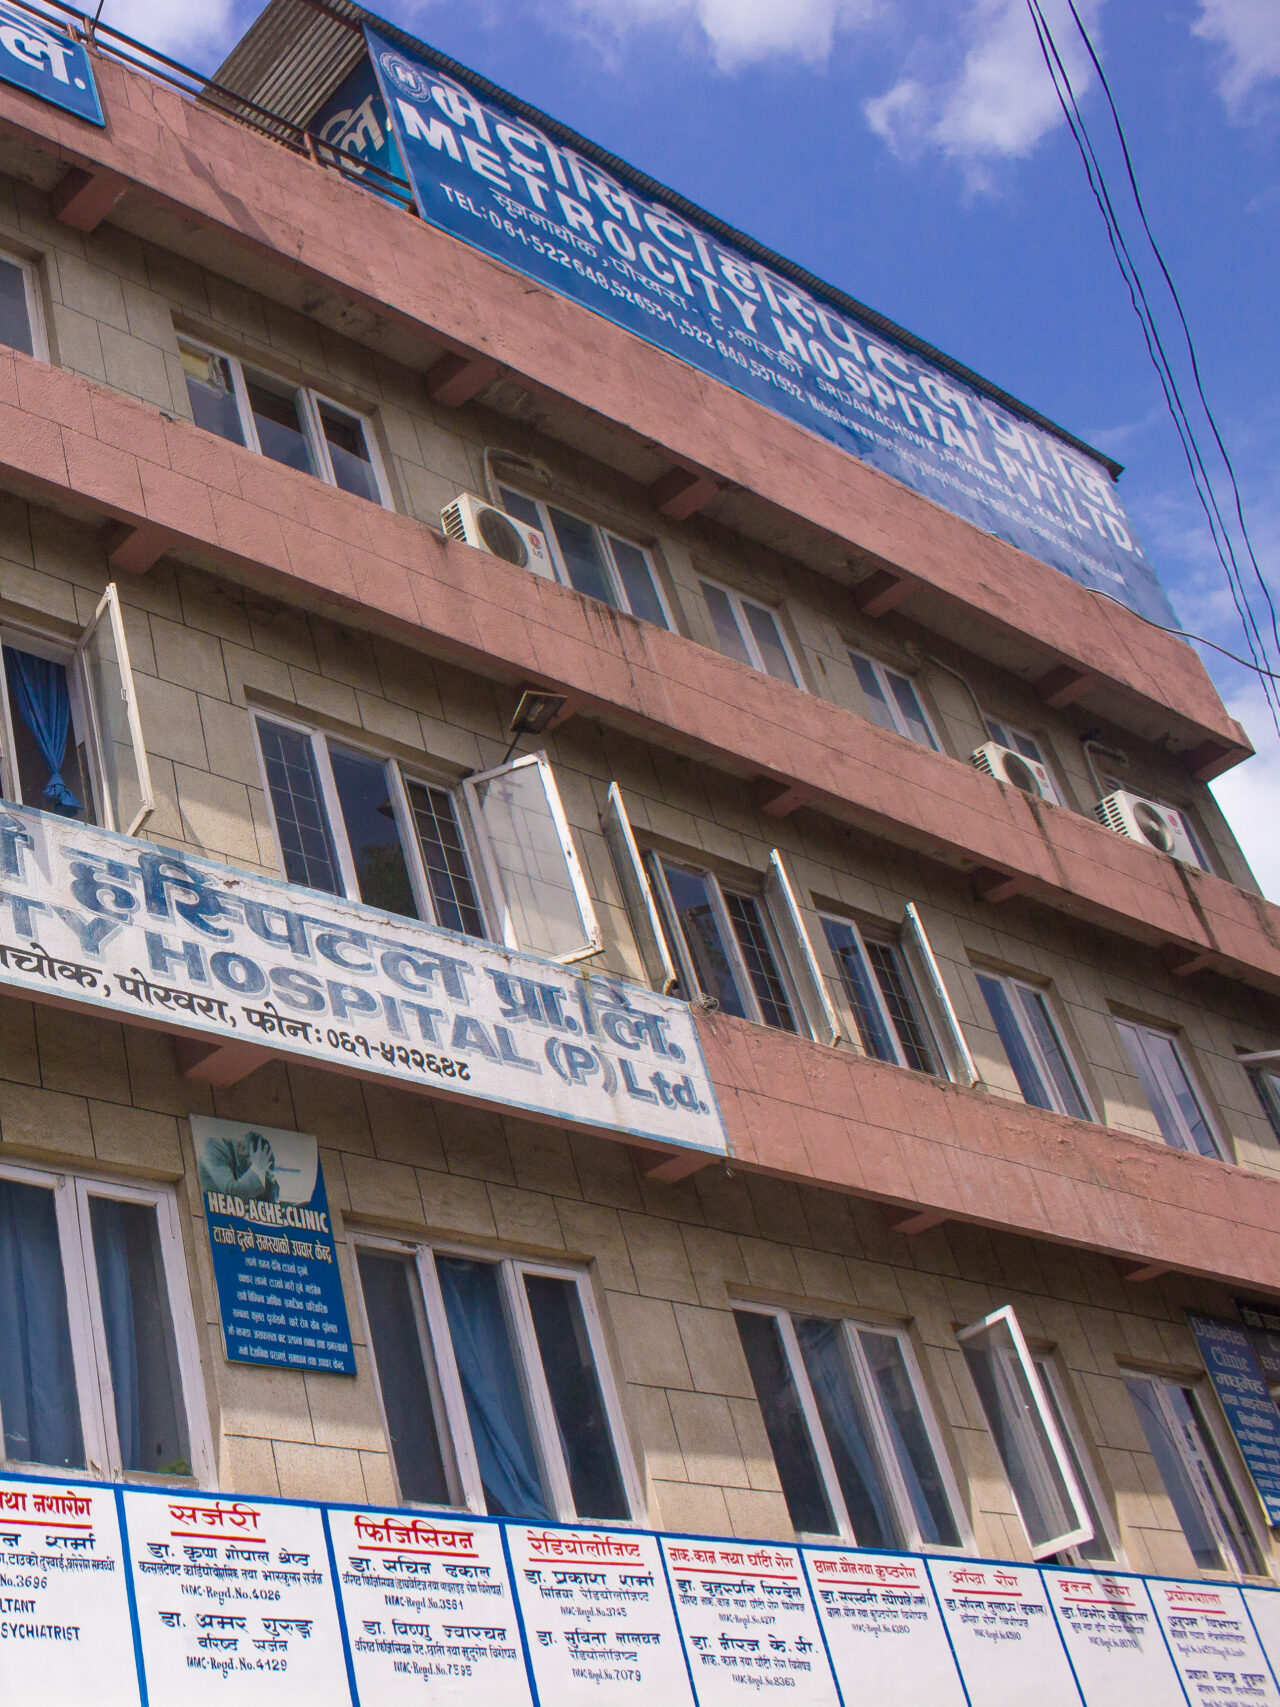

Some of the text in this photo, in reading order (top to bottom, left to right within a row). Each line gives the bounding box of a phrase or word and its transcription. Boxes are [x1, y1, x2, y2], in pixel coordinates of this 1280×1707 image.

[396, 97, 757, 334] METROCITY
[771, 315, 998, 474] HOSPITAL
[57, 843, 476, 1004] हस्पिटल
[146, 929, 540, 1074] HOSPITAL
[285, 1207, 329, 1234] CLINIC
[168, 1501, 261, 1531] सर्जरी
[45, 1532, 96, 1551] शर्मा
[147, 1542, 270, 1562] डा. गोपाल
[348, 1557, 376, 1573] डा.
[382, 1555, 432, 1575] सचिन
[523, 1569, 546, 1585] डा.
[676, 1579, 695, 1593] डा.
[158, 1611, 247, 1630] डा. अमर
[362, 1620, 385, 1636] डा.
[536, 1631, 557, 1647] डा.
[690, 1636, 711, 1651] डा.
